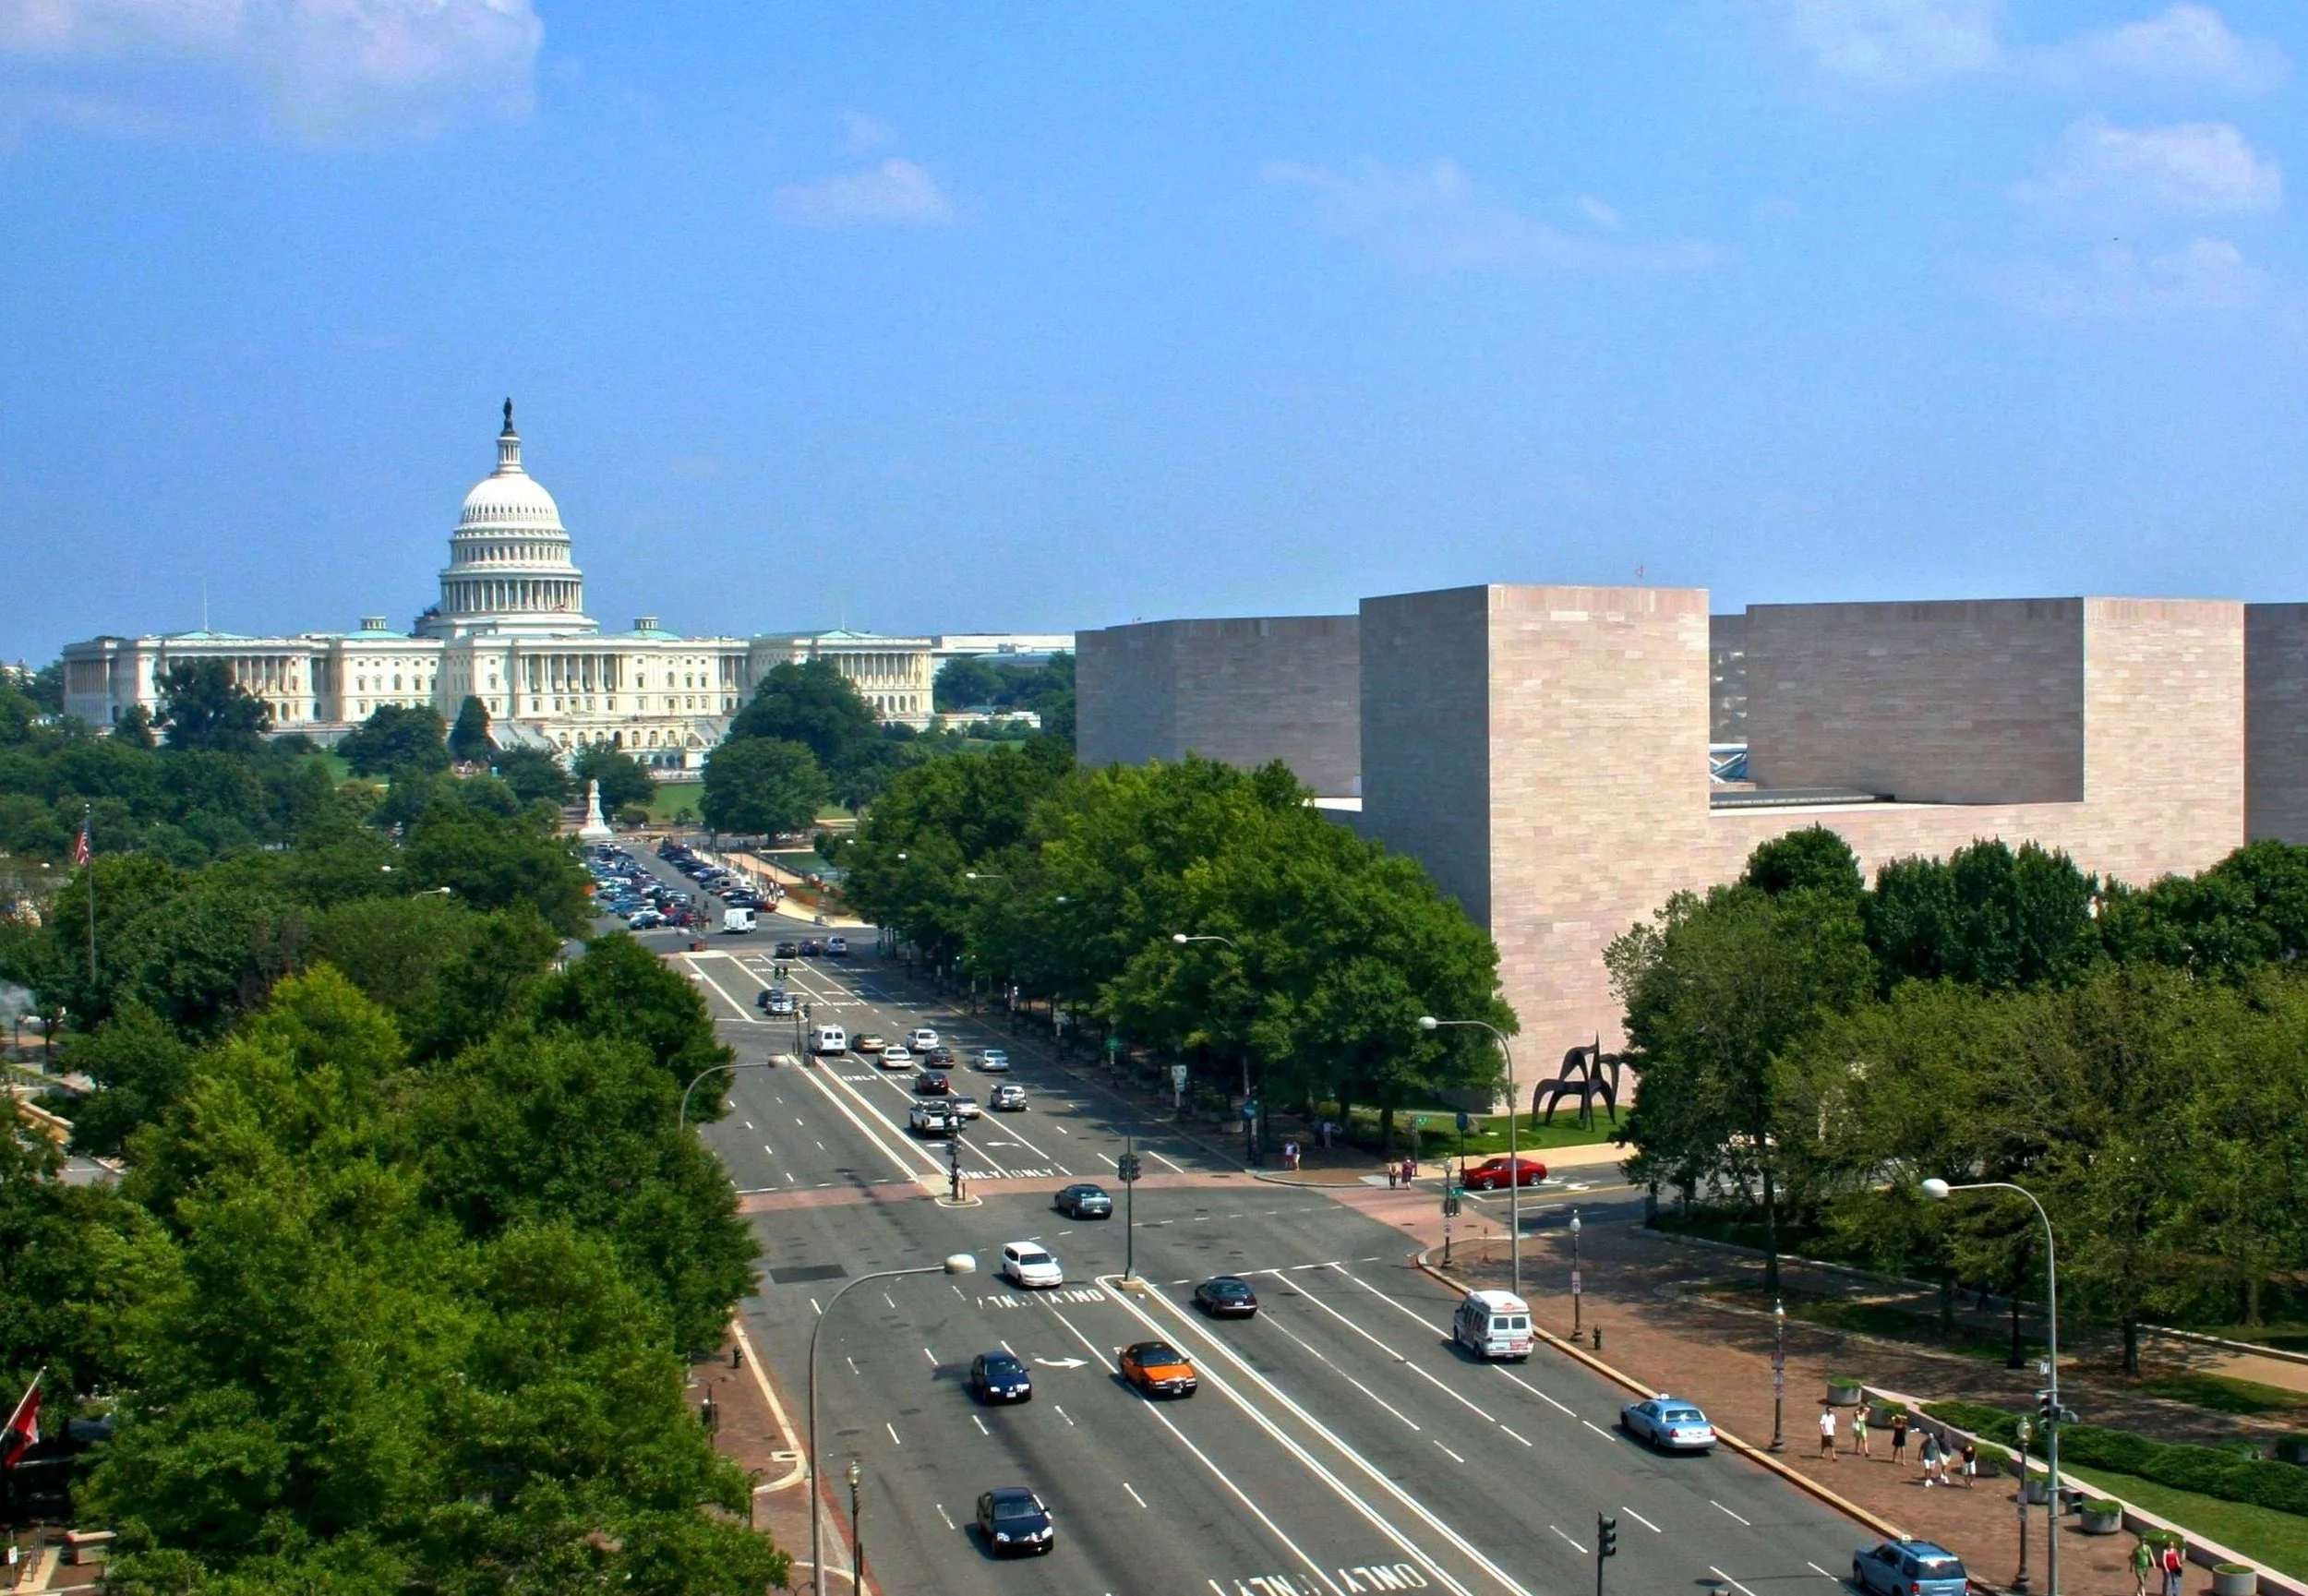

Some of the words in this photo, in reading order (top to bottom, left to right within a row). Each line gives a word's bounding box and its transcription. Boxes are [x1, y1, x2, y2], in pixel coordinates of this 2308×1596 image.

[1010, 1169, 1054, 1178] ONLY
[1048, 1290, 1105, 1303] ONLY
[1338, 1563, 1428, 1593] ONLY
